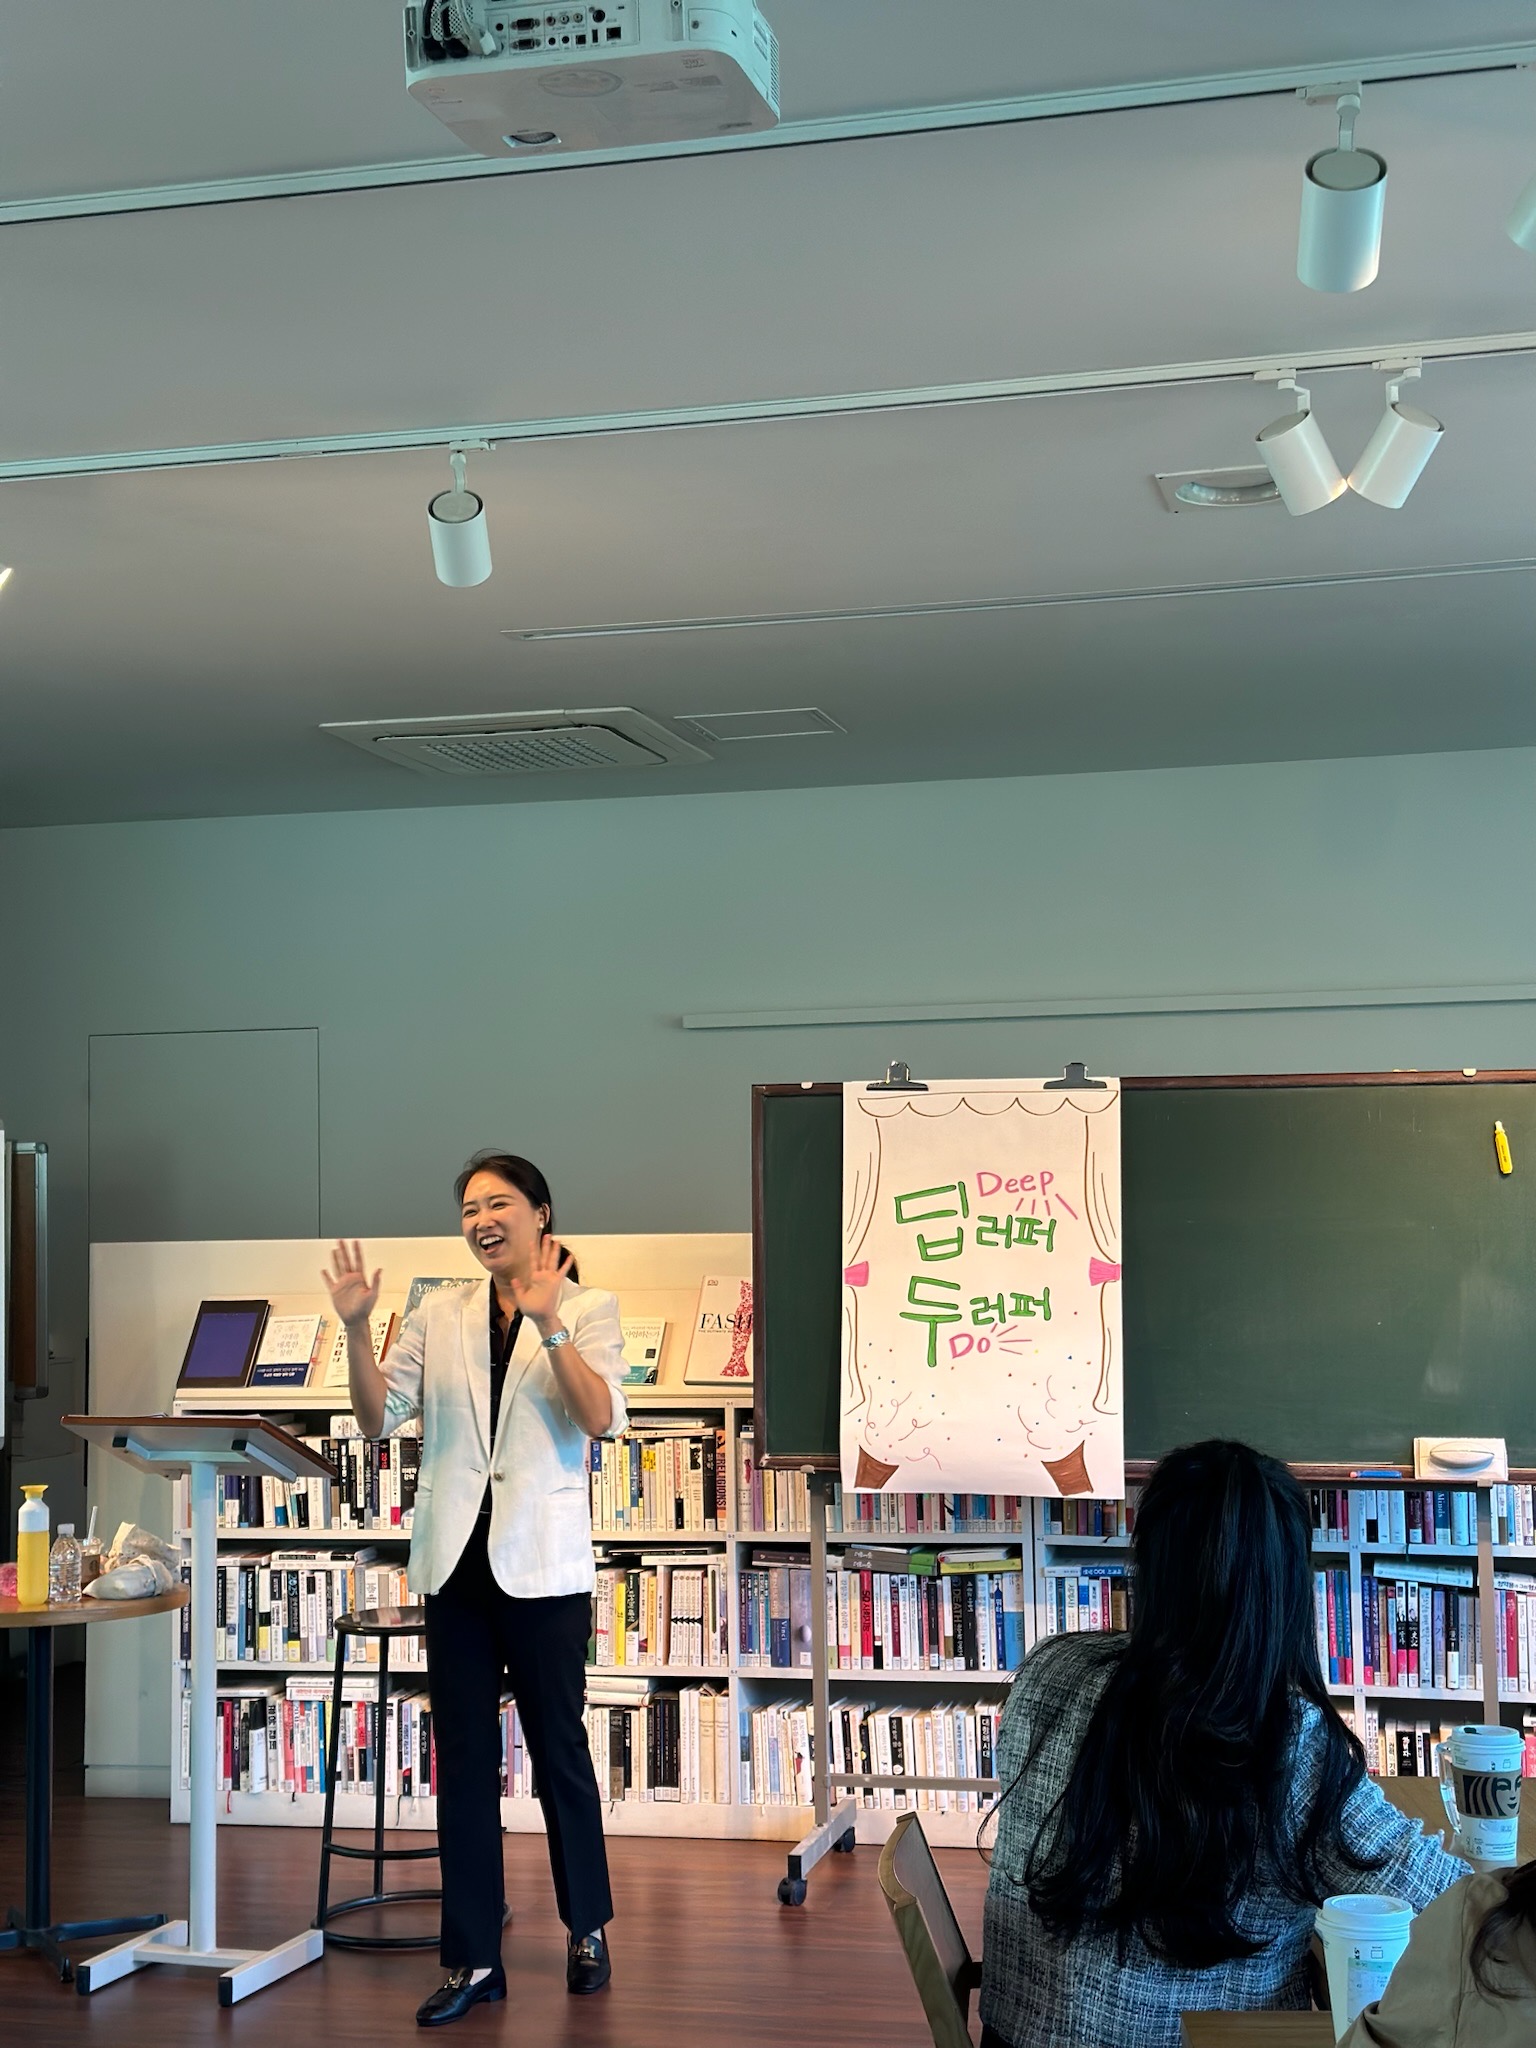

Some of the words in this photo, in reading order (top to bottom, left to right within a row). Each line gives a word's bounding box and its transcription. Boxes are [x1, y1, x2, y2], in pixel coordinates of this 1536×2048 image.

[975, 1170, 1055, 1198] Deep
[893, 1181, 1057, 1262] 딥러퍼
[899, 1275, 1051, 1368] 두러퍼
[948, 1332, 991, 1359] Do
[1437, 1492, 1445, 1518] Minds
[952, 1588, 963, 1623] DEATH
